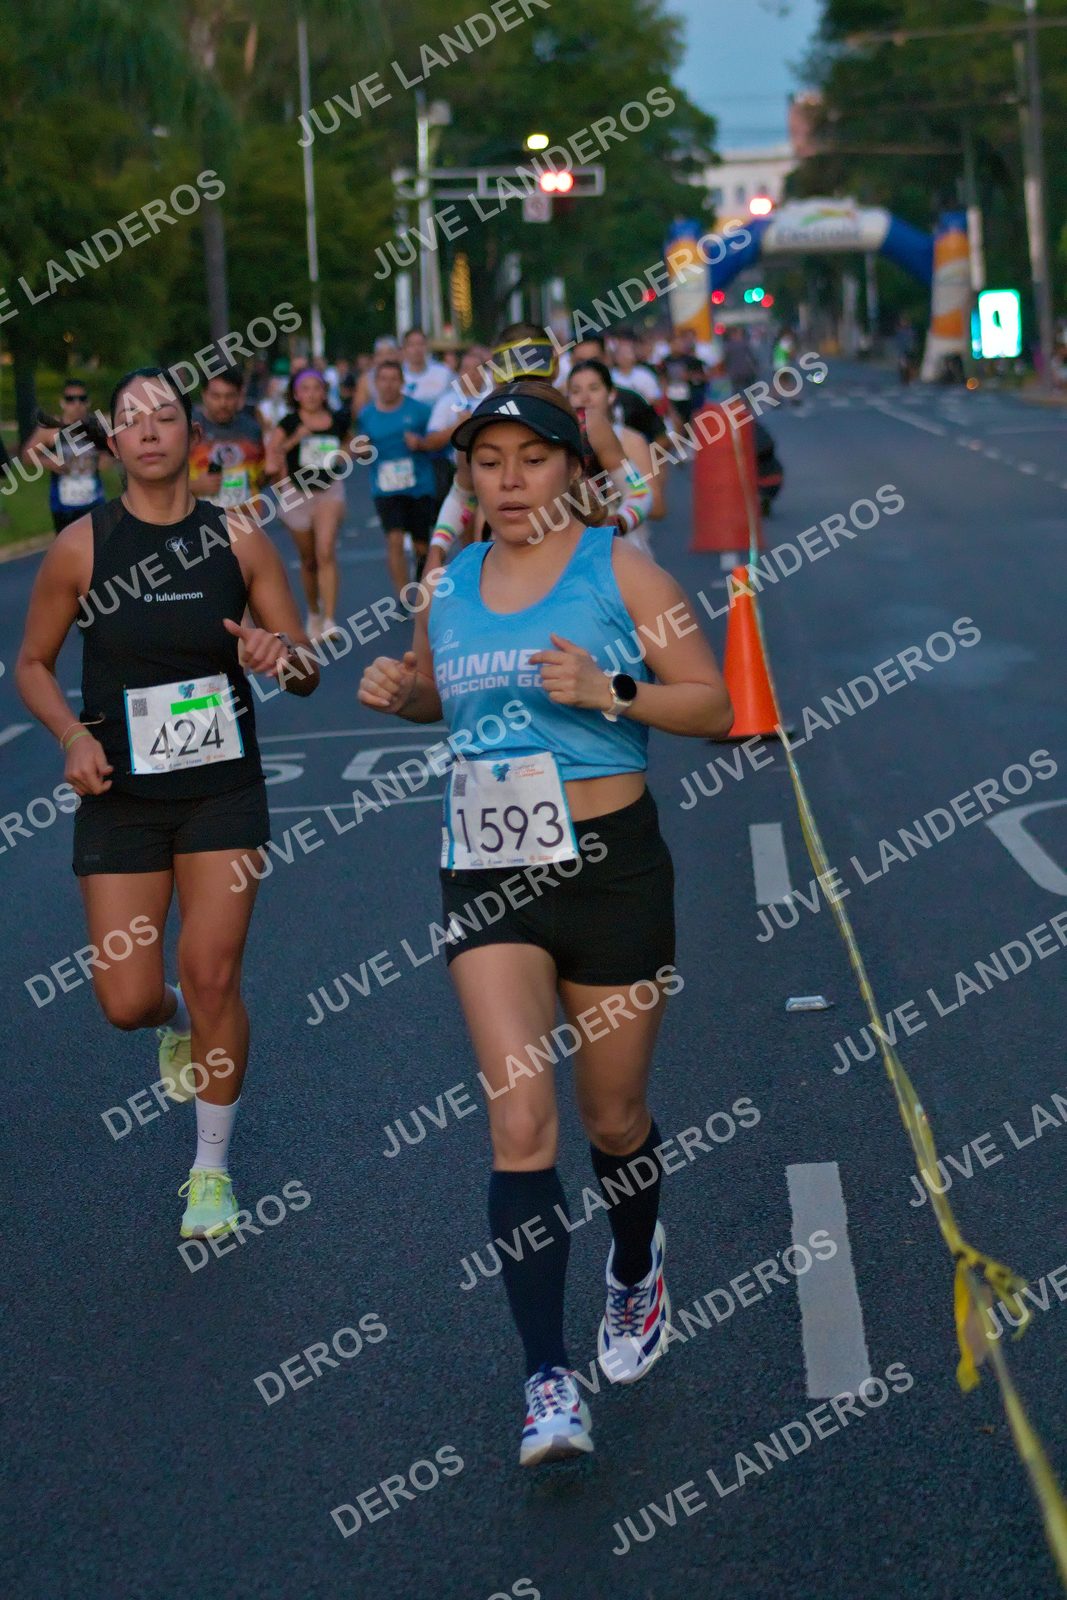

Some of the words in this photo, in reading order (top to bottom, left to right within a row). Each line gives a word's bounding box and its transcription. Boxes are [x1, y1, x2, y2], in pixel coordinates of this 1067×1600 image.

[156, 591, 203, 602] lululemon
[436, 648, 552, 685] RUNNE
[150, 712, 224, 759] 424
[457, 801, 564, 855] 1593
